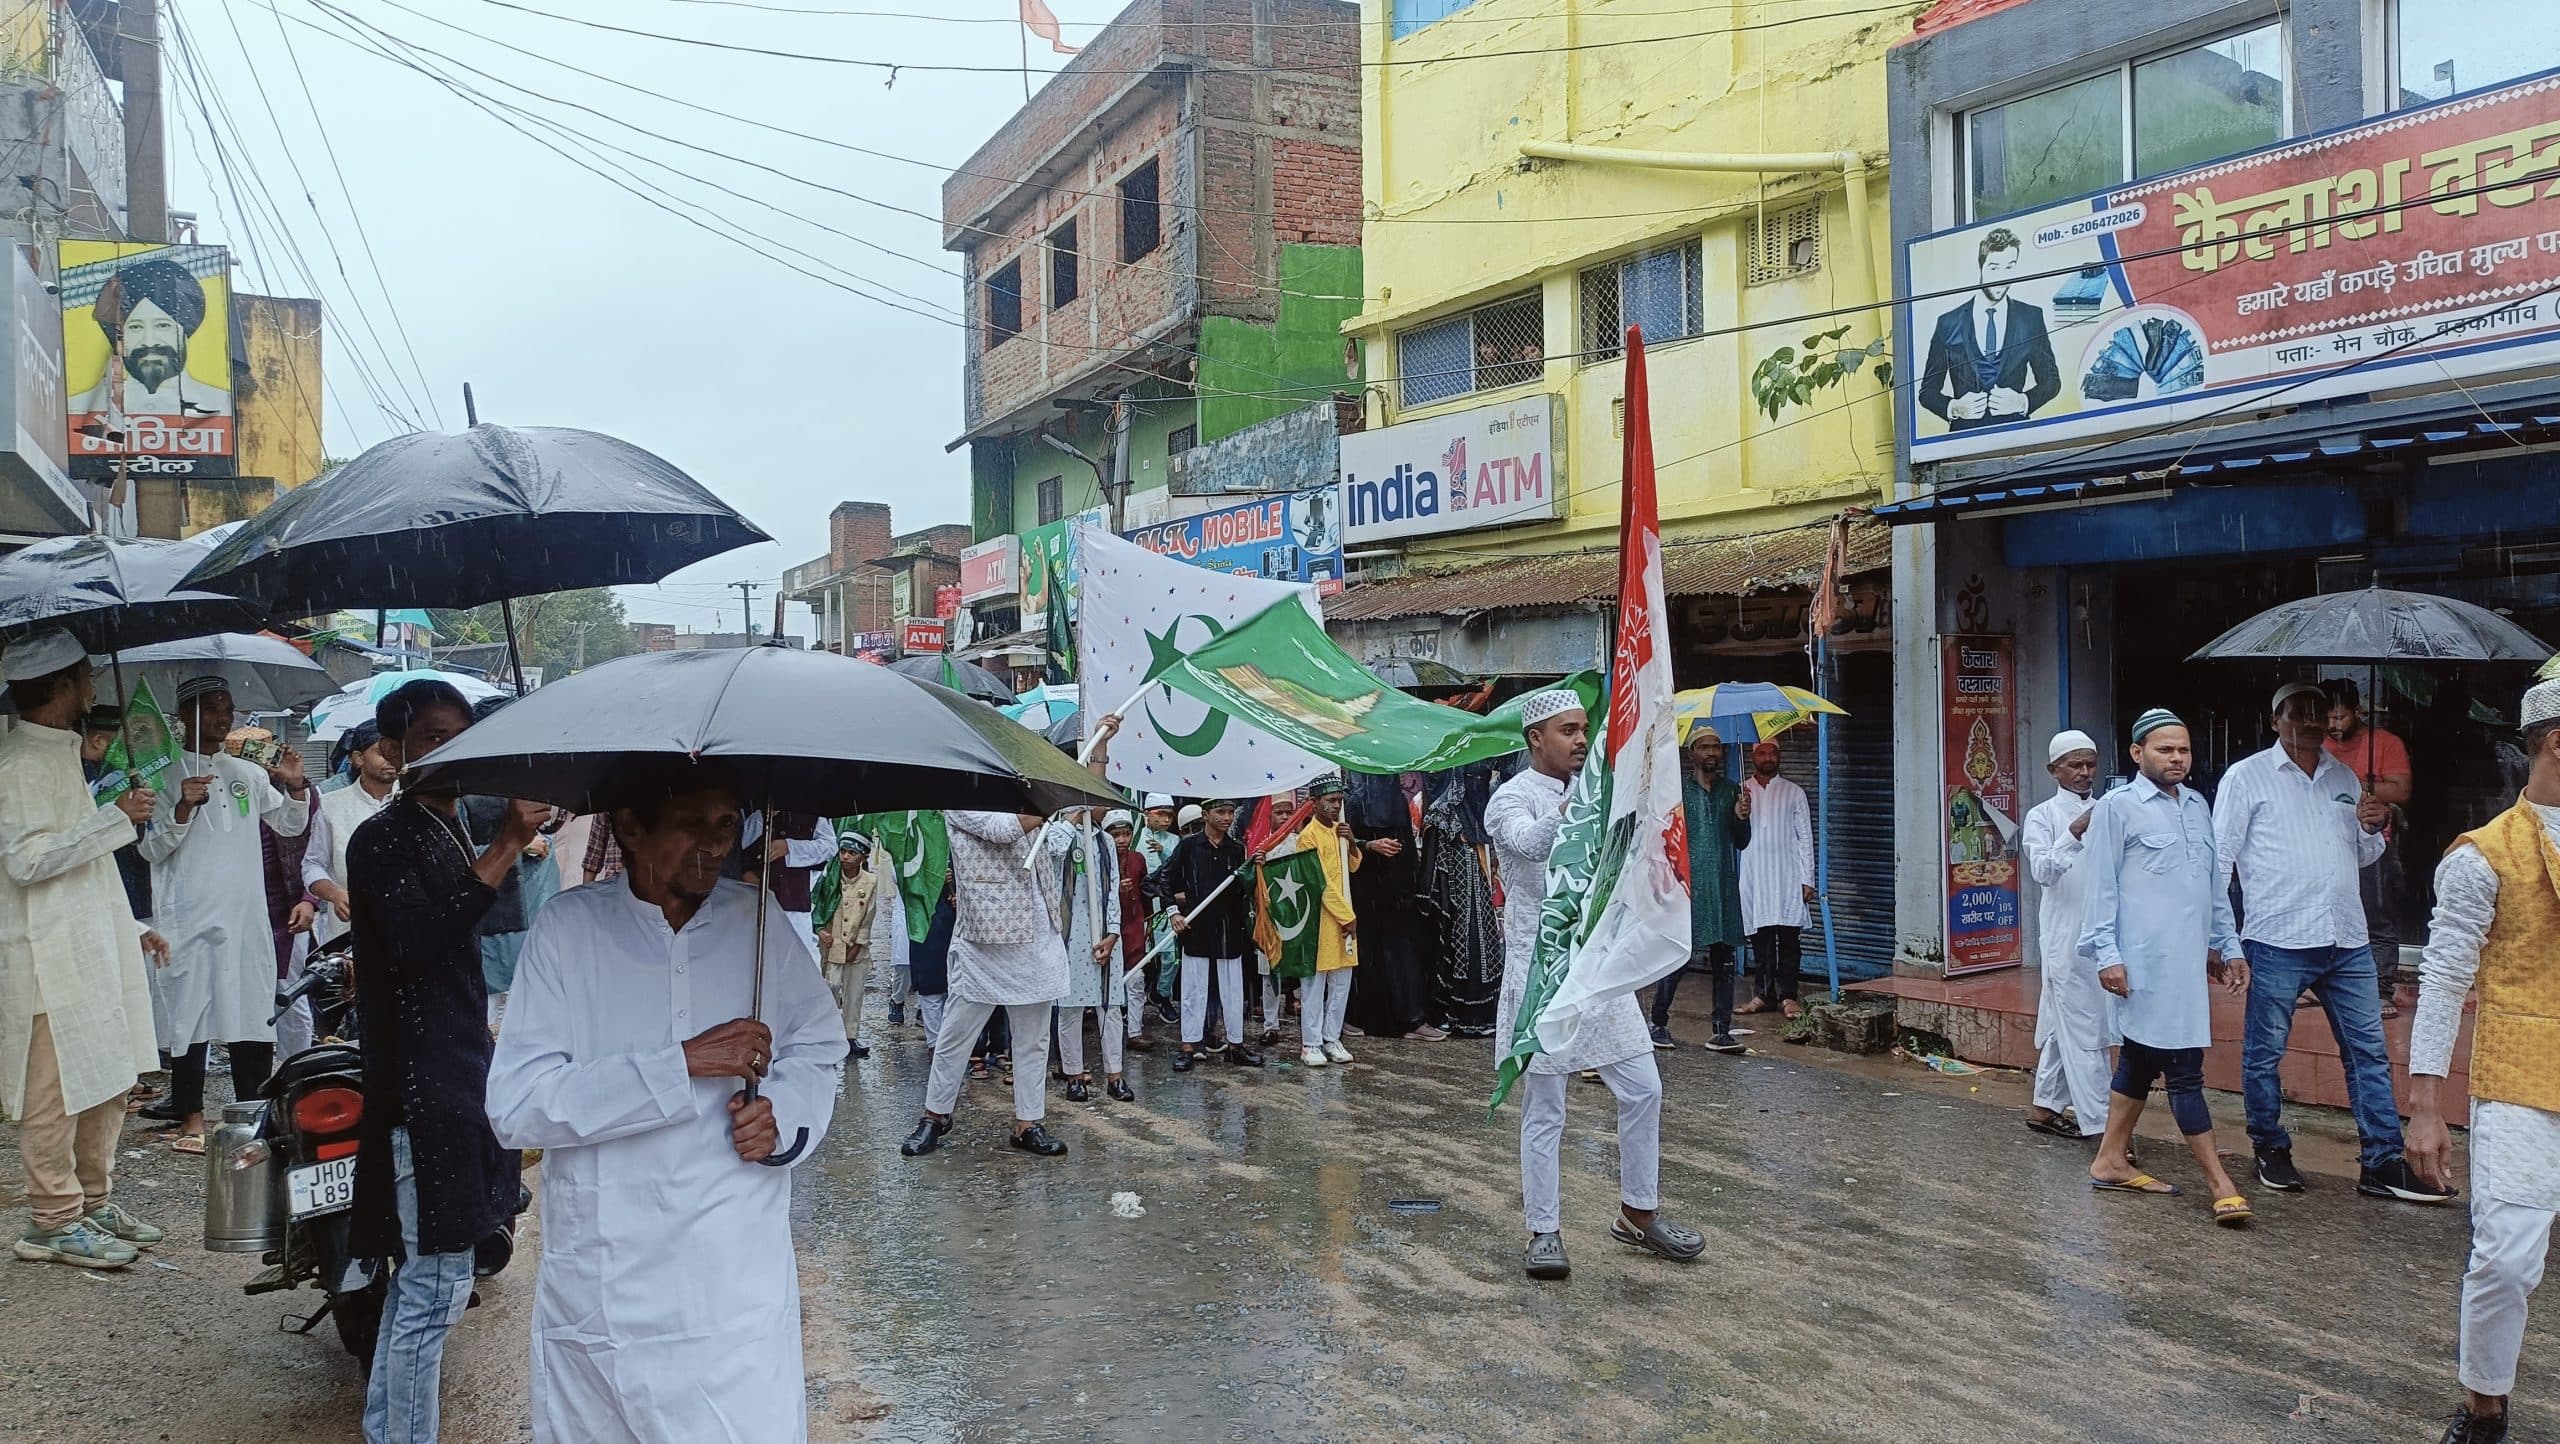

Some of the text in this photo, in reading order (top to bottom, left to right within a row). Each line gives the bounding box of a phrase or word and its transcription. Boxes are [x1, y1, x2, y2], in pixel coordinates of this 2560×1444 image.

[2071, 208, 2141, 236] 6206472026
[2173, 157, 2411, 272] कैलाश
[2237, 230, 2560, 316] हमारे यहाँ कपड़े उचित मुल्य प
[2333, 333, 2361, 354] मेन
[1347, 463, 1440, 527] india
[1472, 452, 1543, 508] ATM
[986, 558, 1006, 585] ATM
[909, 631, 943, 645] ATM
[1961, 646, 1998, 669] कैलाश
[1957, 675, 2003, 693] वस्त्रालय
[1961, 910, 1995, 925] खरीद पर
[1998, 915, 2014, 926] OFF
